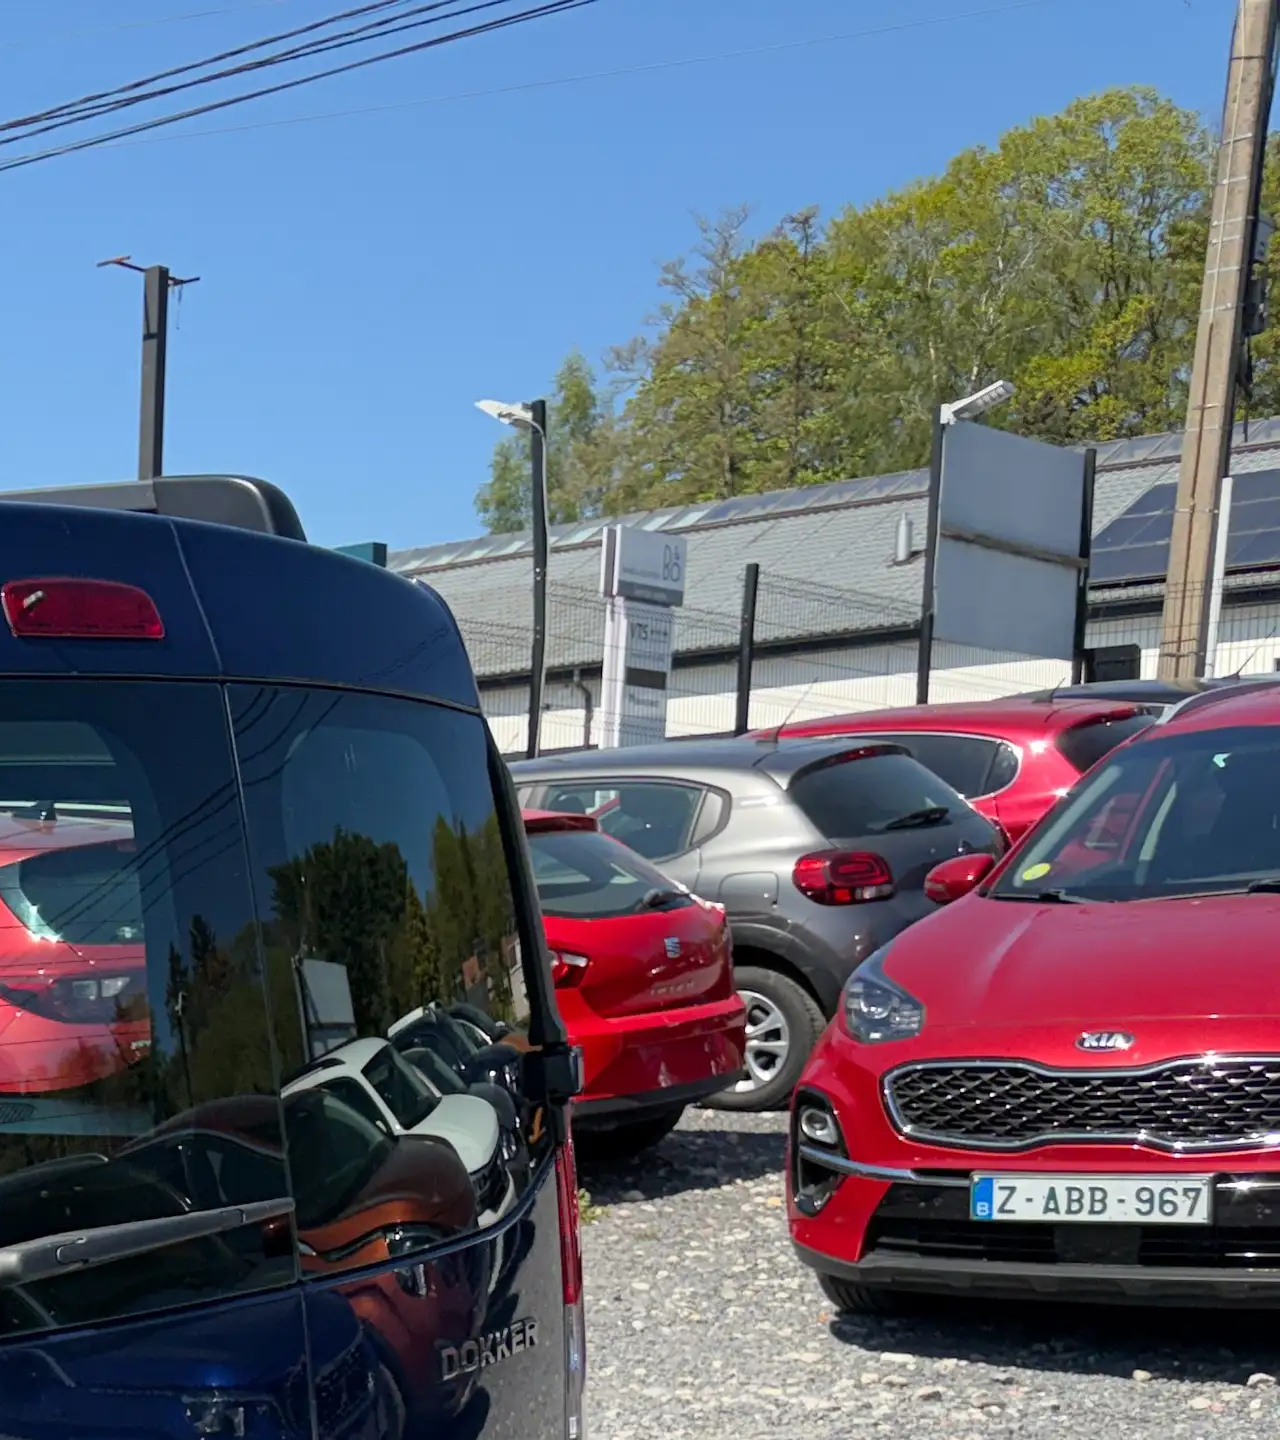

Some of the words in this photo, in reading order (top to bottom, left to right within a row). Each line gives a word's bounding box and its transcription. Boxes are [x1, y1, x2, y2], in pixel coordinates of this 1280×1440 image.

[1081, 1031, 1129, 1050] KIA
[976, 1202, 990, 1215] B
[441, 1316, 540, 1381] DOKKER
